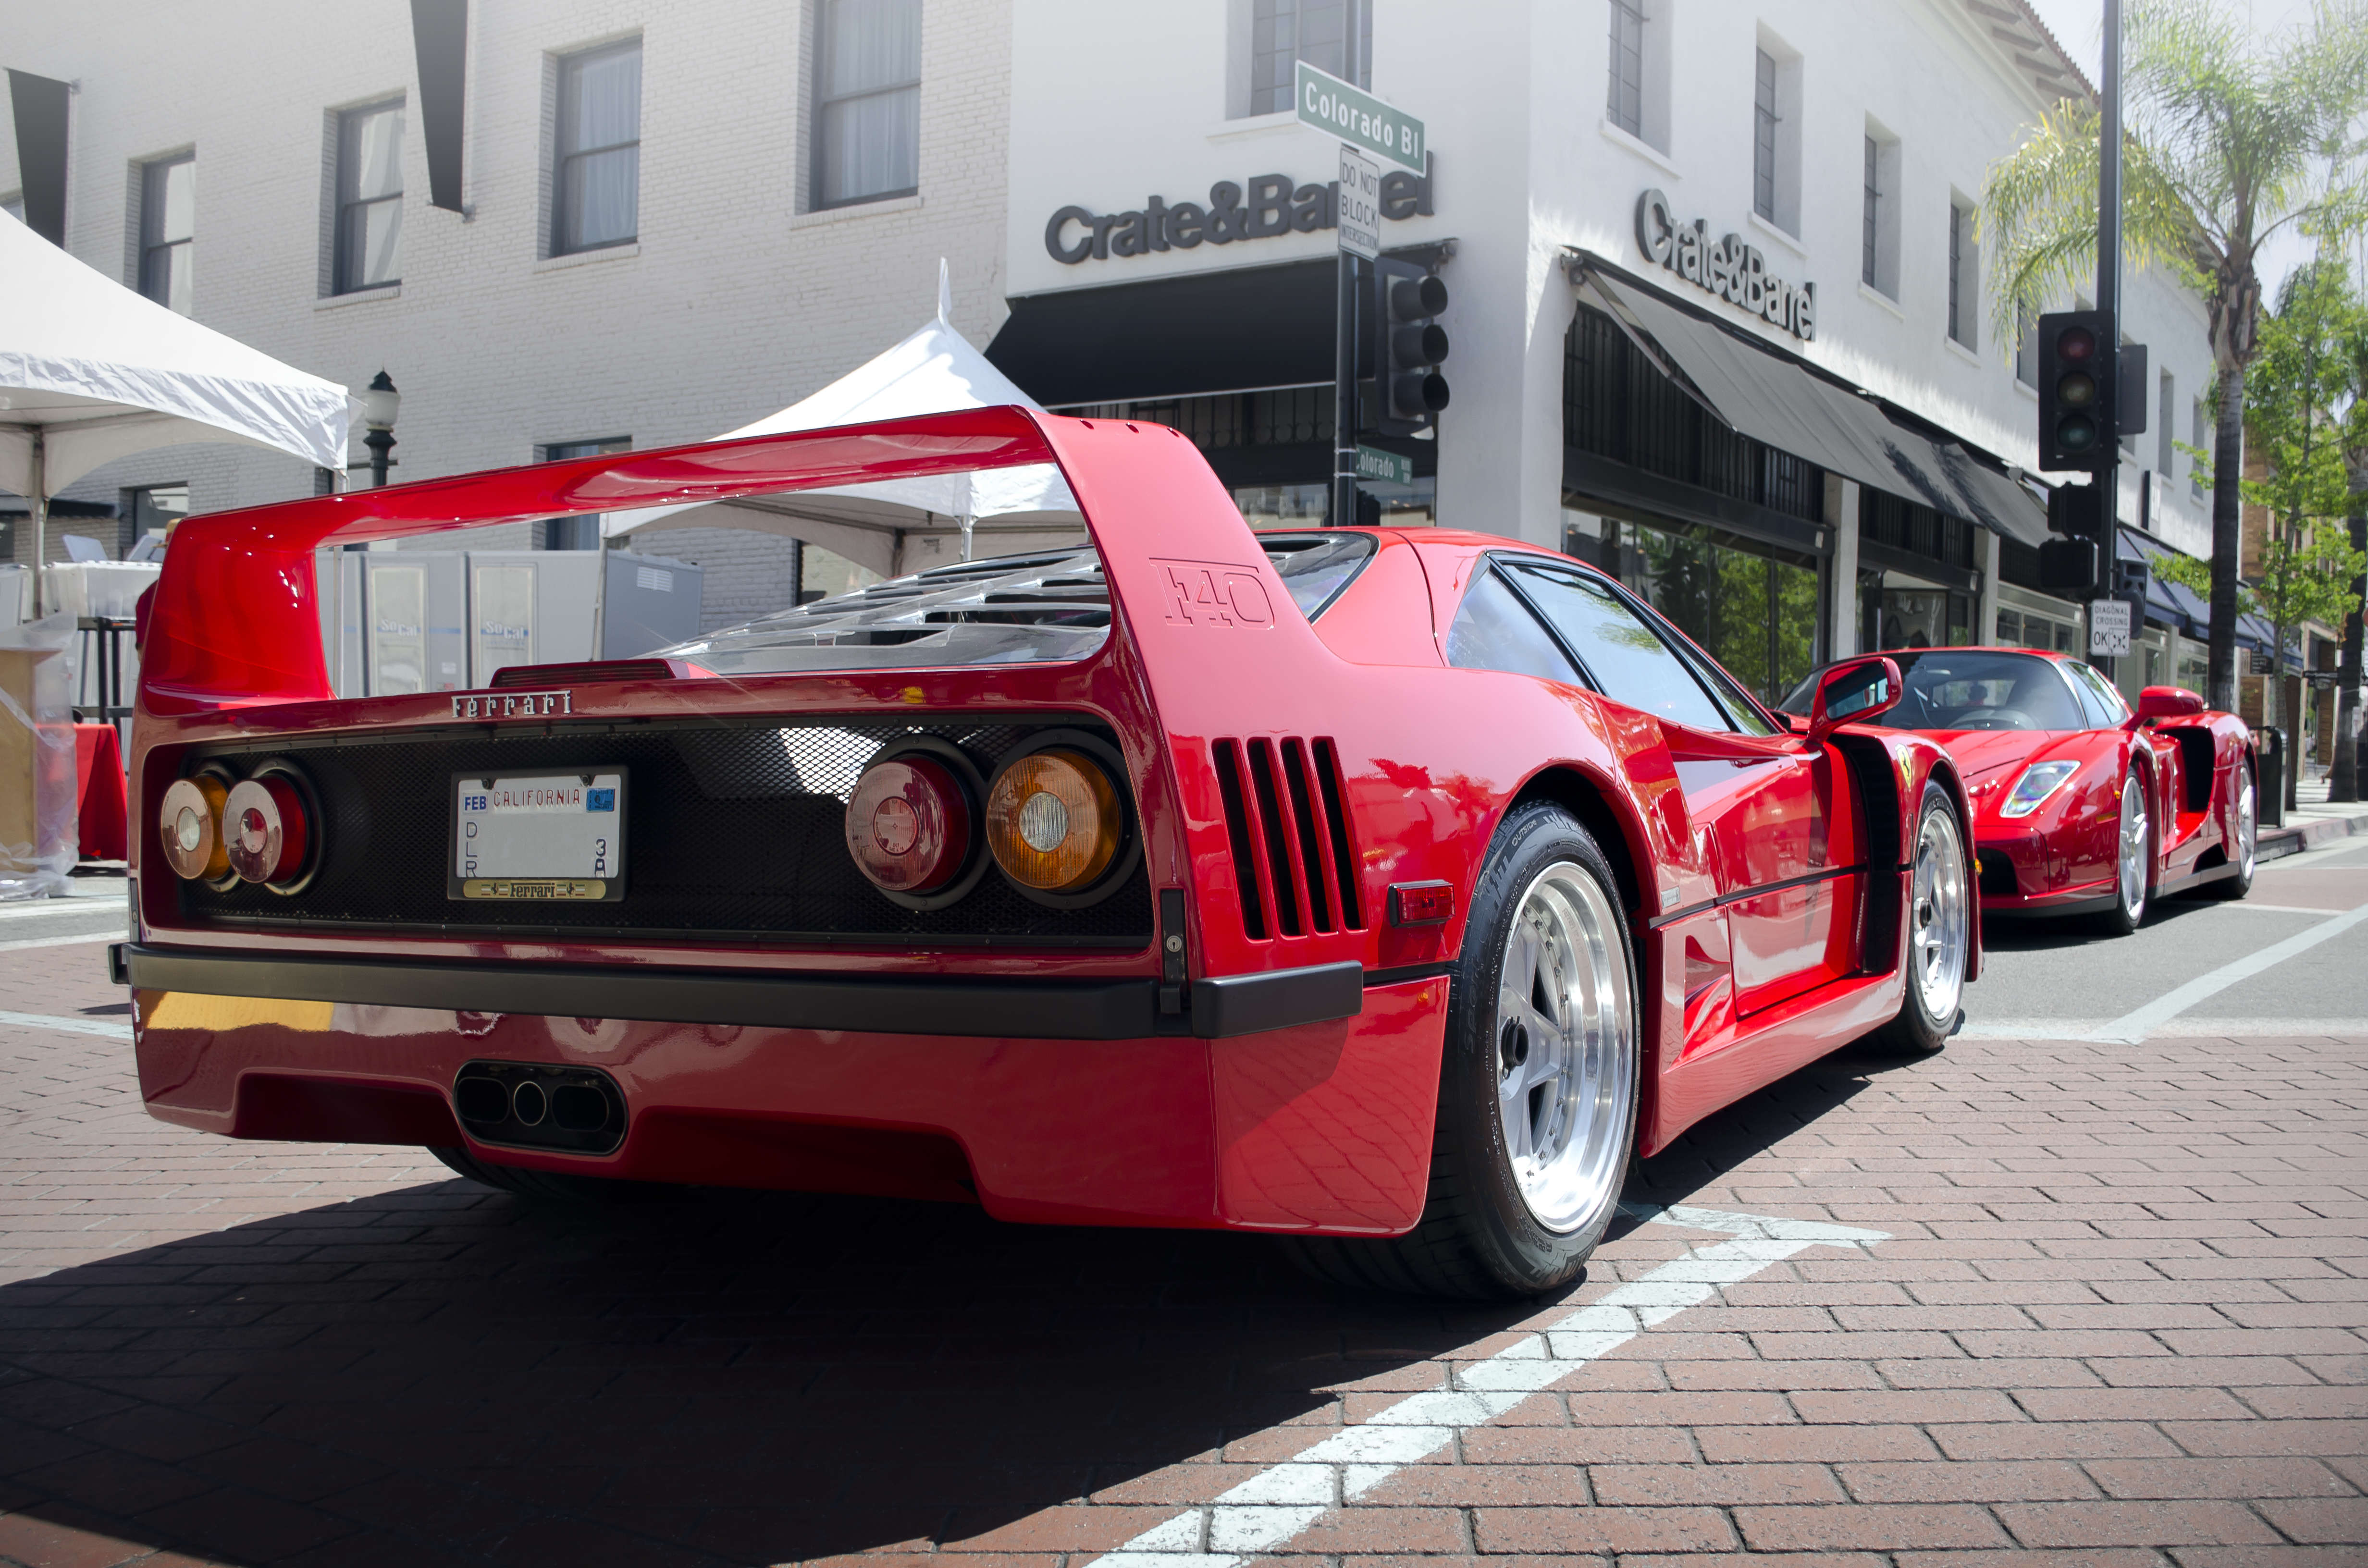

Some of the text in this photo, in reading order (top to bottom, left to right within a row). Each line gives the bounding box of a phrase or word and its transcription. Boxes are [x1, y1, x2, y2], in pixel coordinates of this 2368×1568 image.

[1305, 81, 1394, 147] Colorado
[1343, 162, 1377, 198] DO NOT
[1046, 150, 1434, 264] Crate&Bael
[1342, 195, 1377, 229] BLOCK
[1341, 223, 1379, 250] INTERSECTION
[1635, 188, 1817, 342] Crate&Barrel
[1356, 448, 1394, 478] olorado
[1147, 557, 1274, 630] F40
[2095, 606, 2128, 615] DIAGONAL
[2096, 616, 2128, 626] CROSSING
[2094, 631, 2108, 646] OK
[451, 690, 570, 718] Ferrari
[465, 796, 487, 811] FEB
[493, 789, 580, 807] CALIFORNIA
[1512, 818, 1537, 847] OUTSIDE
[510, 882, 555, 898] Ferrari
